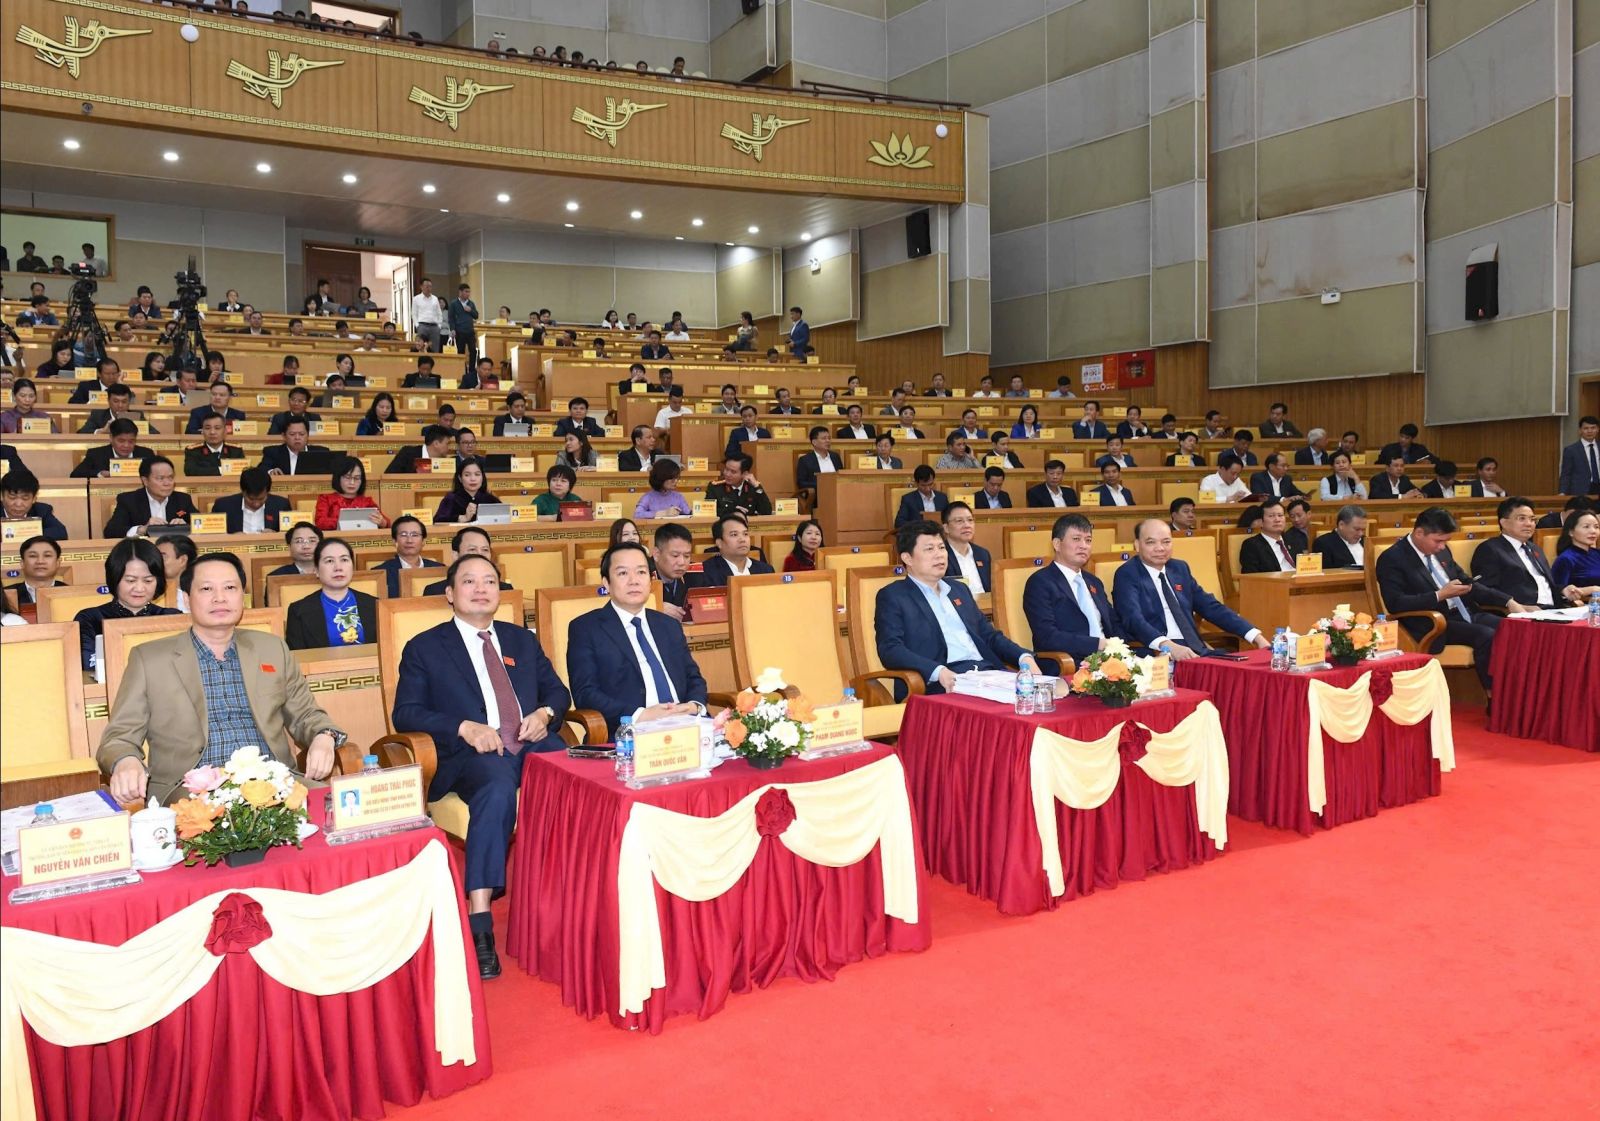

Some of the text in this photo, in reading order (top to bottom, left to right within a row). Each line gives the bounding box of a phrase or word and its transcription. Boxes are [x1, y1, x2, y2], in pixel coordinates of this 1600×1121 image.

[34, 857, 70, 874] NGUYỄN
[73, 855, 91, 869] VĂN
[93, 851, 120, 865] CHIẾN
